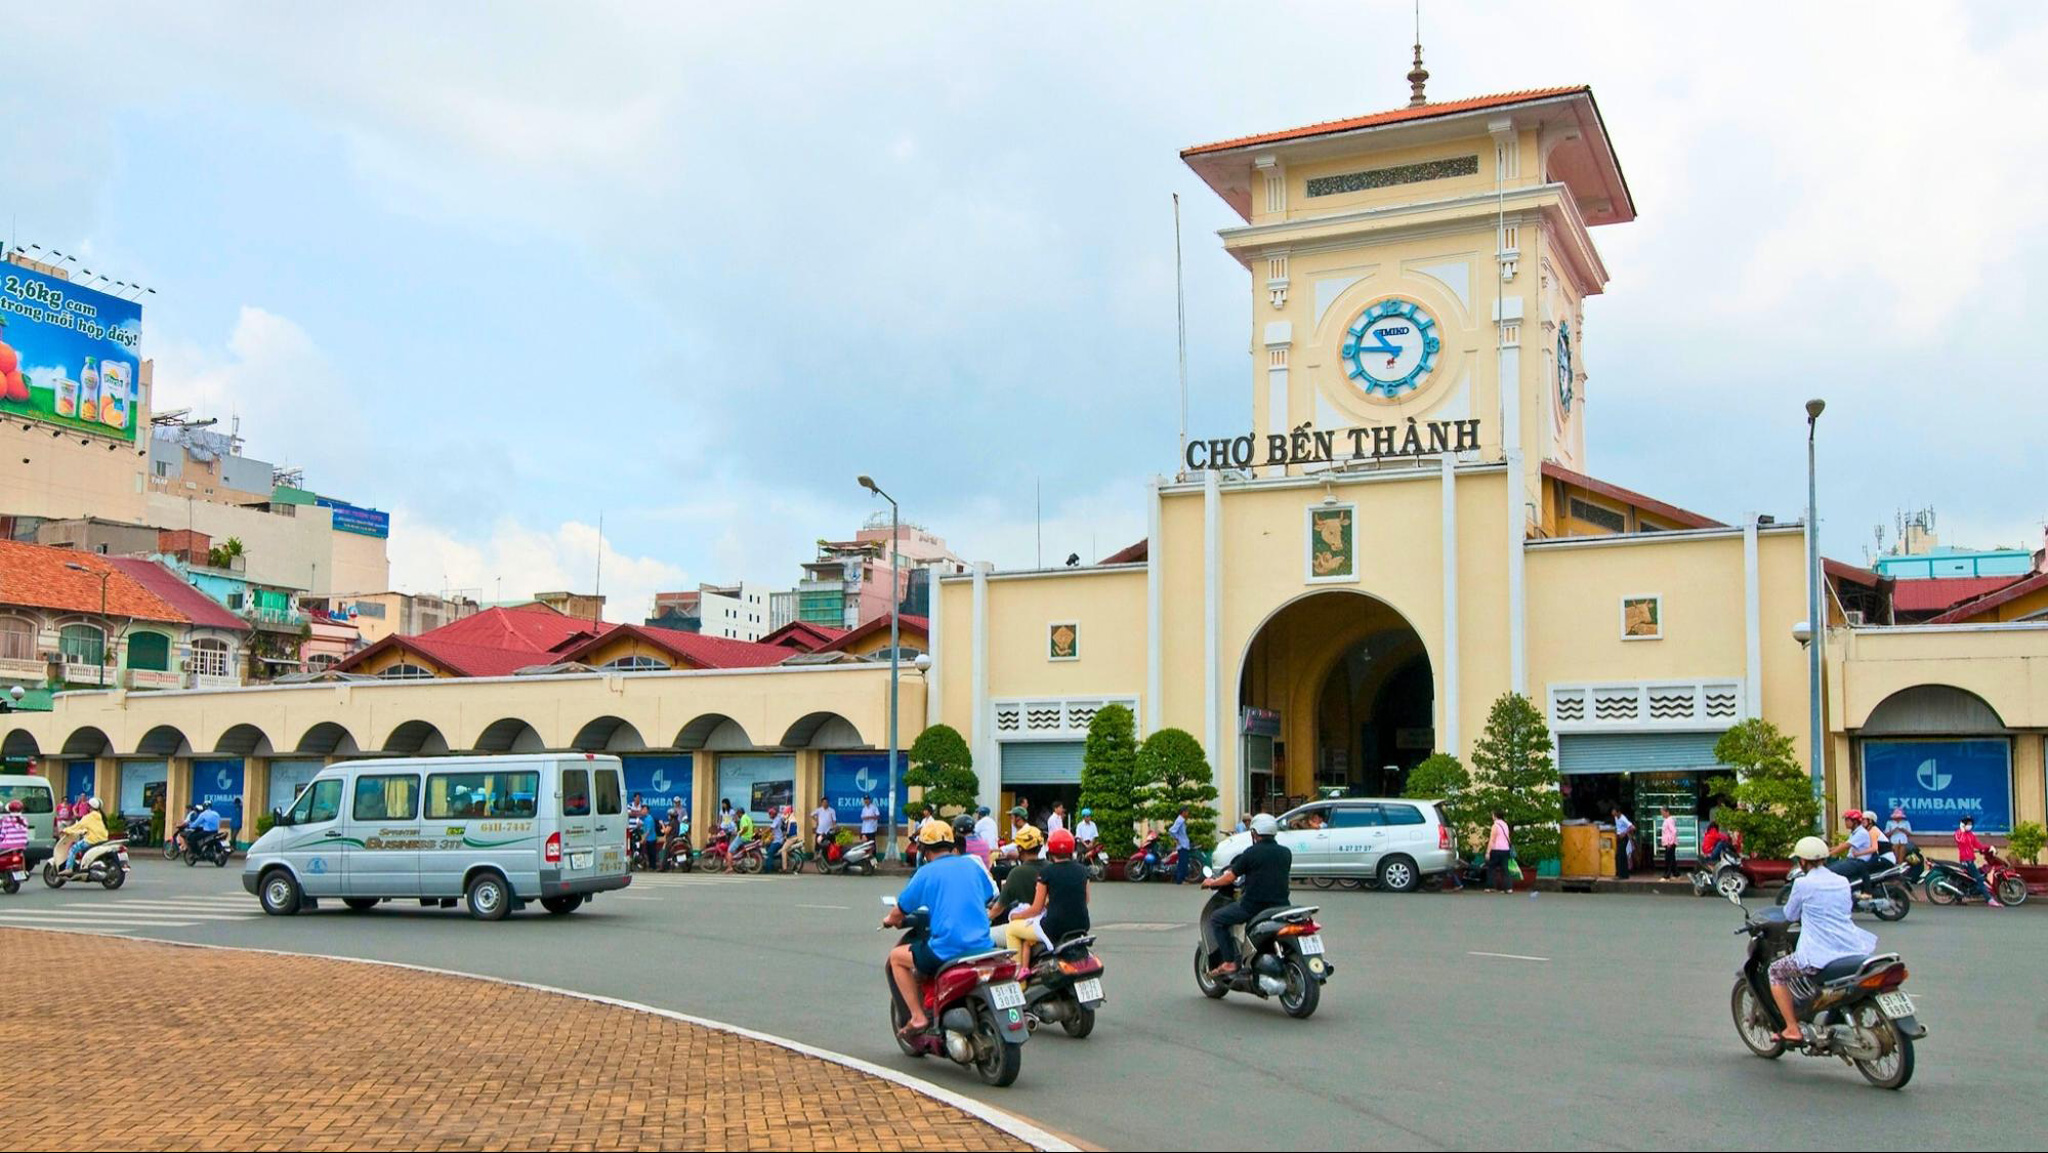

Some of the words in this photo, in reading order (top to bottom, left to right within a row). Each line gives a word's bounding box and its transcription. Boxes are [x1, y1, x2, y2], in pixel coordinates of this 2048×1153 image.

[0, 297, 42, 321] trong
[5, 277, 62, 309] 2,6kg
[66, 300, 96, 317] cam
[1186, 432, 1256, 472] CHỢ
[1266, 421, 1335, 465] BẾN
[1347, 417, 1481, 459] THÀNH
[1888, 797, 1983, 810] EXIMBANK
